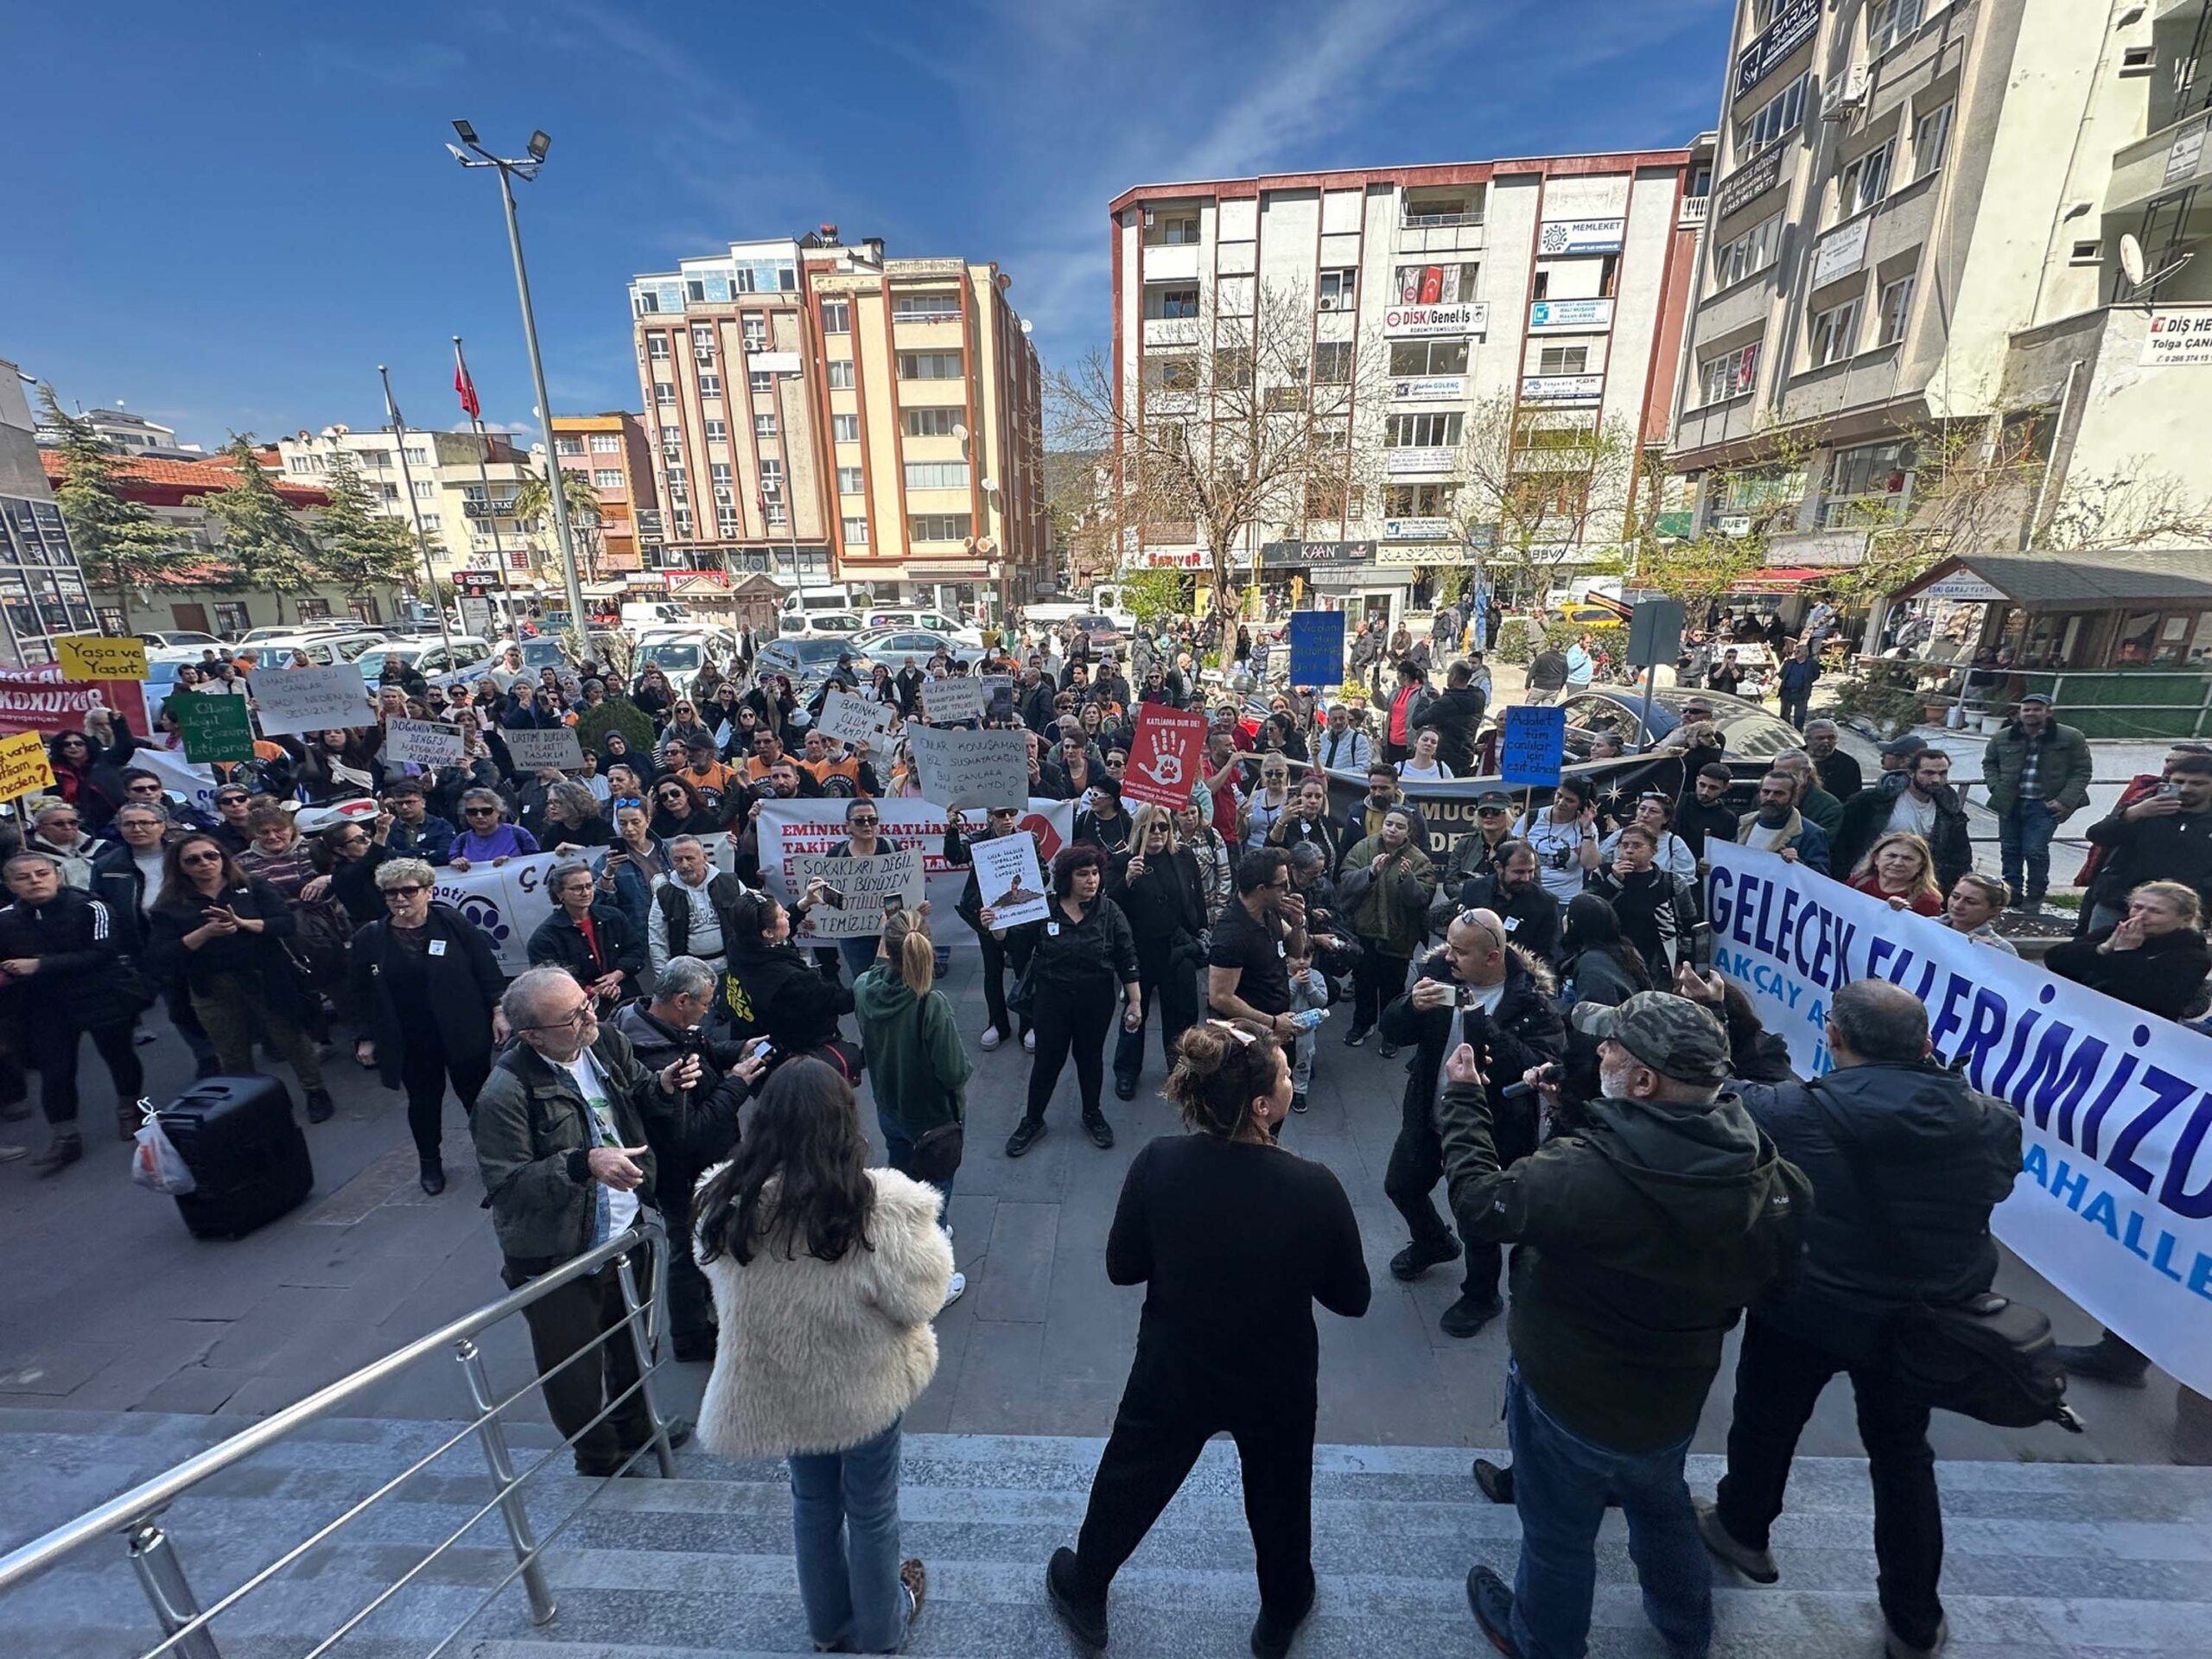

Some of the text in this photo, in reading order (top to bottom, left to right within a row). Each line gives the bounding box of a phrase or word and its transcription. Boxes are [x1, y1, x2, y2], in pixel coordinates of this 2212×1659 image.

[1573, 221, 1621, 232] MEMLEKET
[2167, 315, 2191, 336] DİŞ
[2152, 339, 2182, 351] Tolga
[66, 642, 143, 660] Yaşa ve
[84, 660, 143, 677] Yaşat.
[840, 699, 880, 719] BARINAK
[1146, 717, 1176, 726] KATLİAMA
[1510, 711, 1555, 726] Adalet
[803, 859, 874, 876] SOKAKLARI
[854, 871, 912, 893] BÜYÜYEN
[1708, 866, 1856, 994] GELECEK
[1714, 947, 1802, 1009] AKÇAY
